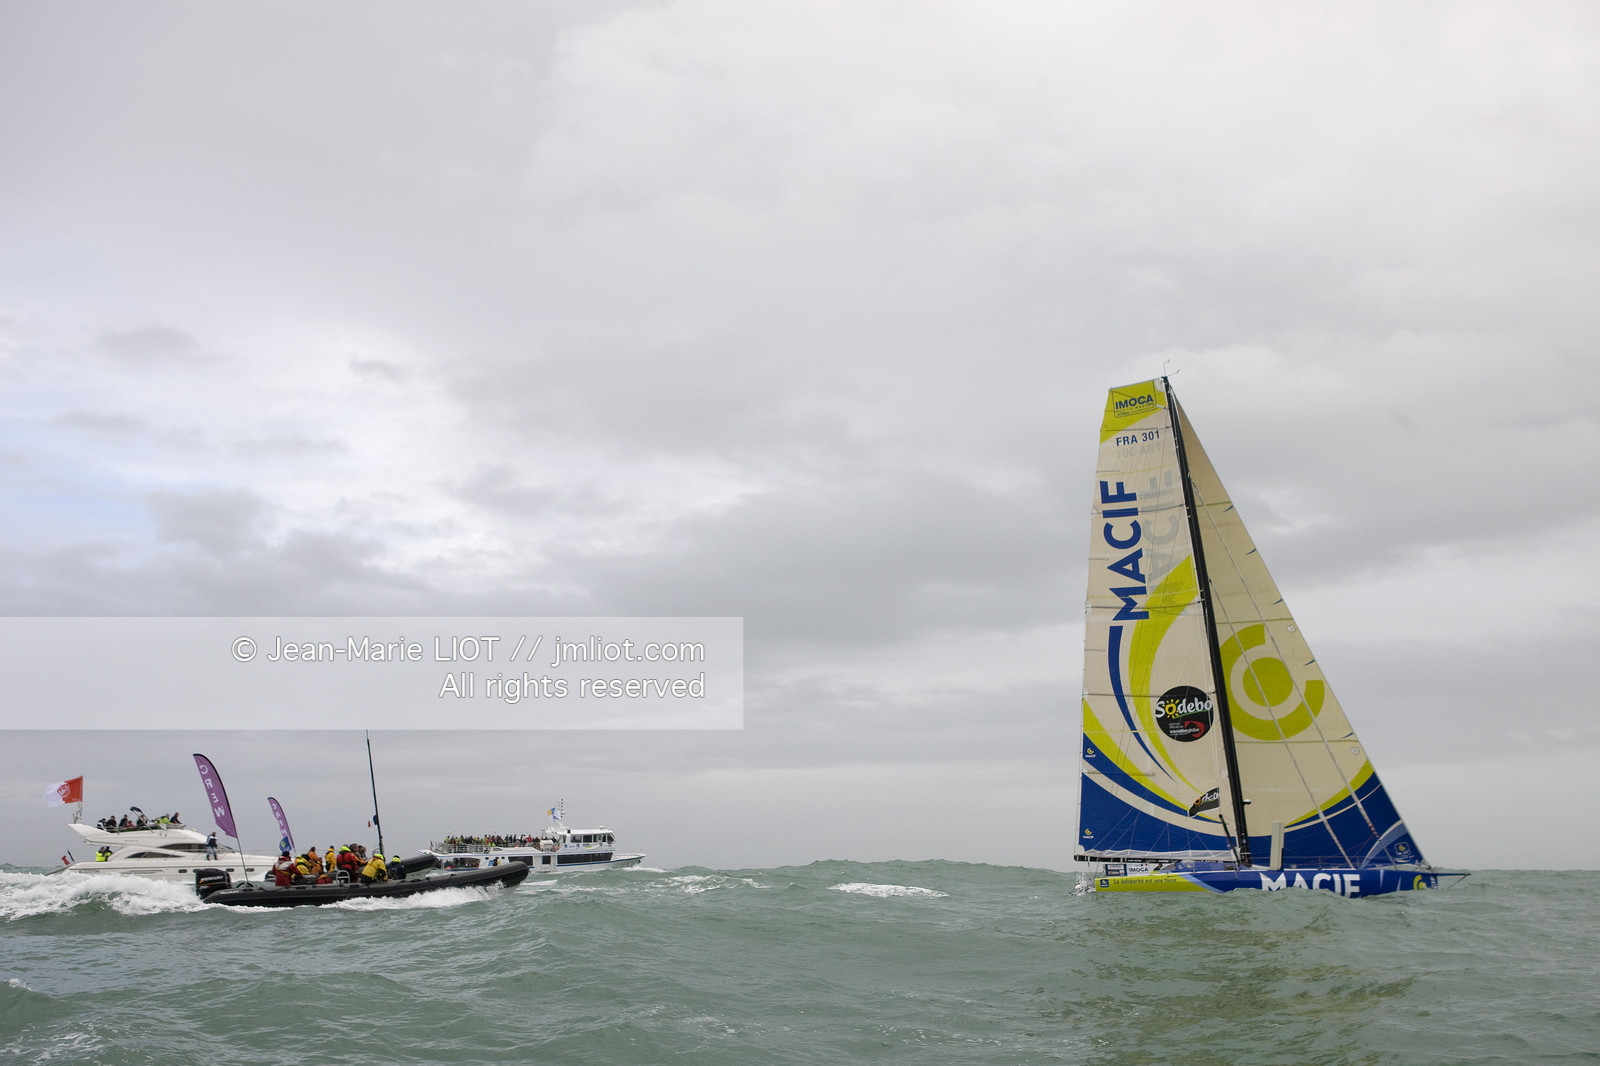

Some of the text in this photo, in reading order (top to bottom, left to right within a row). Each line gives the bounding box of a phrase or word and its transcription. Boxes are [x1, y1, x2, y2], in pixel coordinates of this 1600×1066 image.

[1115, 394, 1154, 410] IMOCA
[1115, 429, 1160, 447] FRA 301
[1100, 480, 1150, 621] MACIF
[1155, 697, 1213, 718] Sodebo
[1259, 872, 1361, 898] MACIF
